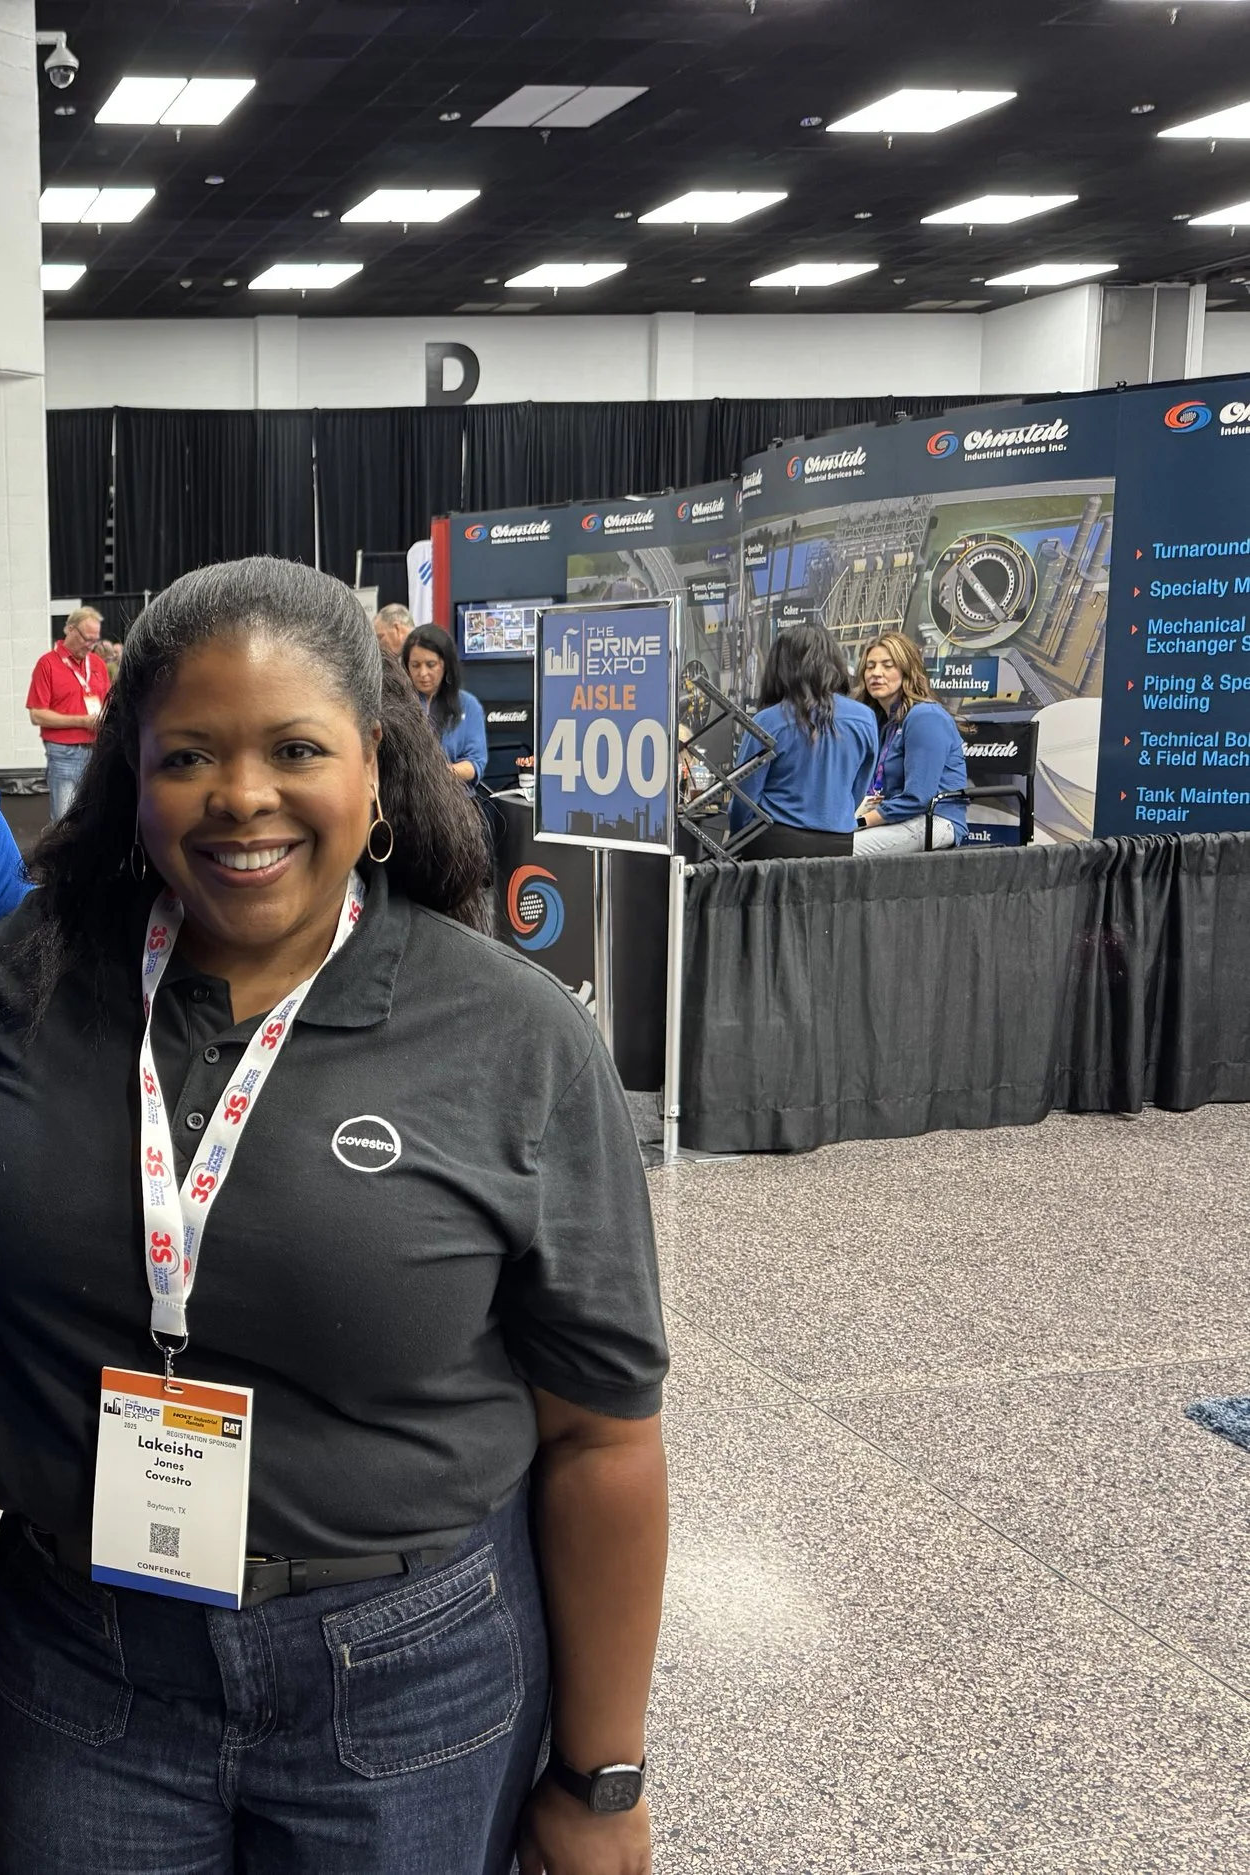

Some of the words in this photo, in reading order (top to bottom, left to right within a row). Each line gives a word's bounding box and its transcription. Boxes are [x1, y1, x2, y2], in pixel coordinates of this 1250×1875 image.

[425, 342, 480, 406] D
[963, 418, 1069, 451] Ohmstede
[804, 446, 866, 475] Ohmstede
[964, 450, 1004, 462] Industrial
[1006, 446, 1046, 457] Services
[1048, 443, 1067, 452] Inc.
[490, 519, 551, 538] Ohmstede
[1152, 538, 1250, 559] Turnaround
[1150, 578, 1229, 599] Specialty
[783, 605, 799, 616] Coker
[587, 626, 614, 637] THE
[1148, 616, 1246, 635] Mechanical
[586, 635, 661, 657] PRIME
[1146, 637, 1237, 656] Exchanger
[586, 657, 646, 676] EXPO
[945, 664, 973, 676] Field
[929, 678, 990, 692] Machining
[1144, 674, 1196, 694] Piping
[1201, 674, 1214, 690] &
[571, 685, 637, 711] AISLE
[1143, 694, 1210, 713] Welding
[1140, 731, 1219, 748] Technical
[540, 718, 668, 798] 400
[1138, 750, 1151, 766] &
[1156, 751, 1197, 766] Field
[1202, 750, 1250, 767] Mach
[1136, 787, 1175, 803] Tank
[1180, 787, 1250, 805] Mainten
[1135, 805, 1189, 824] Repair
[965, 830, 991, 842] ank
[148, 925, 168, 950] 3S
[260, 1023, 283, 1050] 3S
[224, 1095, 247, 1125] 3S
[337, 1135, 394, 1152] covestro
[146, 1146, 165, 1178] 3S
[191, 1173, 215, 1203] 3S
[151, 1231, 172, 1264] 3S
[124, 1403, 160, 1417] PRIME
[125, 1398, 139, 1406] THE
[123, 1410, 154, 1423] EXPO
[123, 1422, 138, 1430] 2025
[173, 1411, 193, 1421] HOLT
[193, 1415, 218, 1425] Industrial
[185, 1419, 205, 1428] Rentals
[223, 1421, 241, 1436] CAT
[138, 1435, 203, 1459] Lakeisha
[166, 1429, 208, 1444] REGISTRATION
[208, 1438, 237, 1450] SPONSOR
[154, 1457, 184, 1472] Jones
[145, 1470, 192, 1487] Covestro
[147, 1500, 176, 1514] Baytown,
[178, 1506, 186, 1515] TX
[137, 1561, 191, 1579] CONFERENCE
